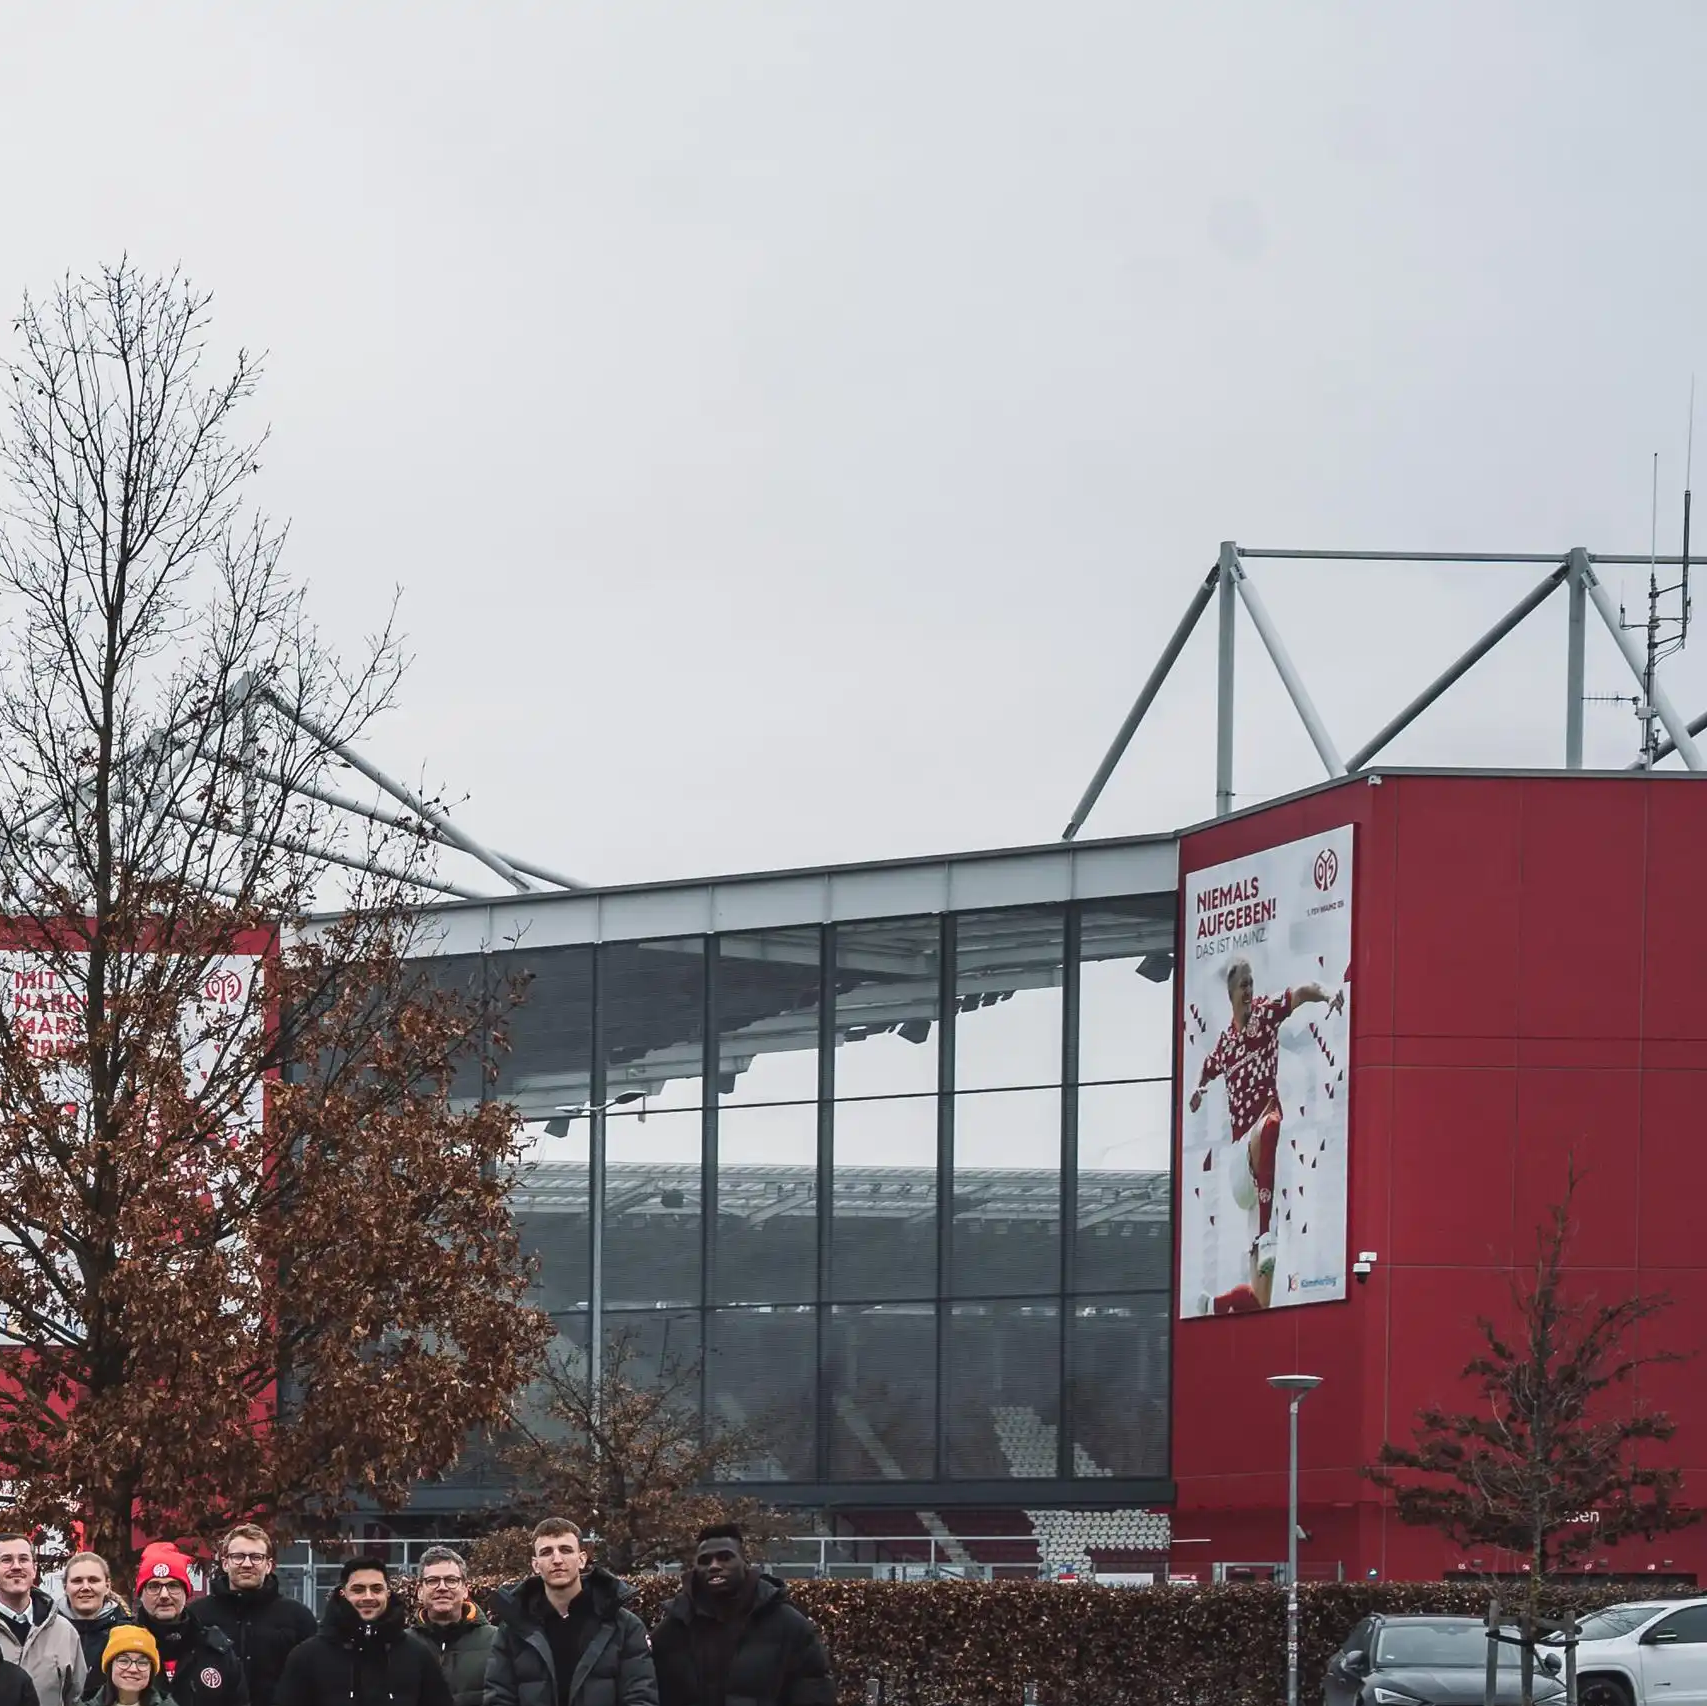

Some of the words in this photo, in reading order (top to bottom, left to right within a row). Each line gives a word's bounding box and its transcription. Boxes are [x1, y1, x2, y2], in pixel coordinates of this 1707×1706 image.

[1197, 876, 1259, 914] NIEMALS
[1197, 898, 1276, 940] AUFGEBEN!
[1196, 941, 1214, 960] DAS
[1217, 937, 1230, 954] IST
[15, 970, 56, 990] MIT
